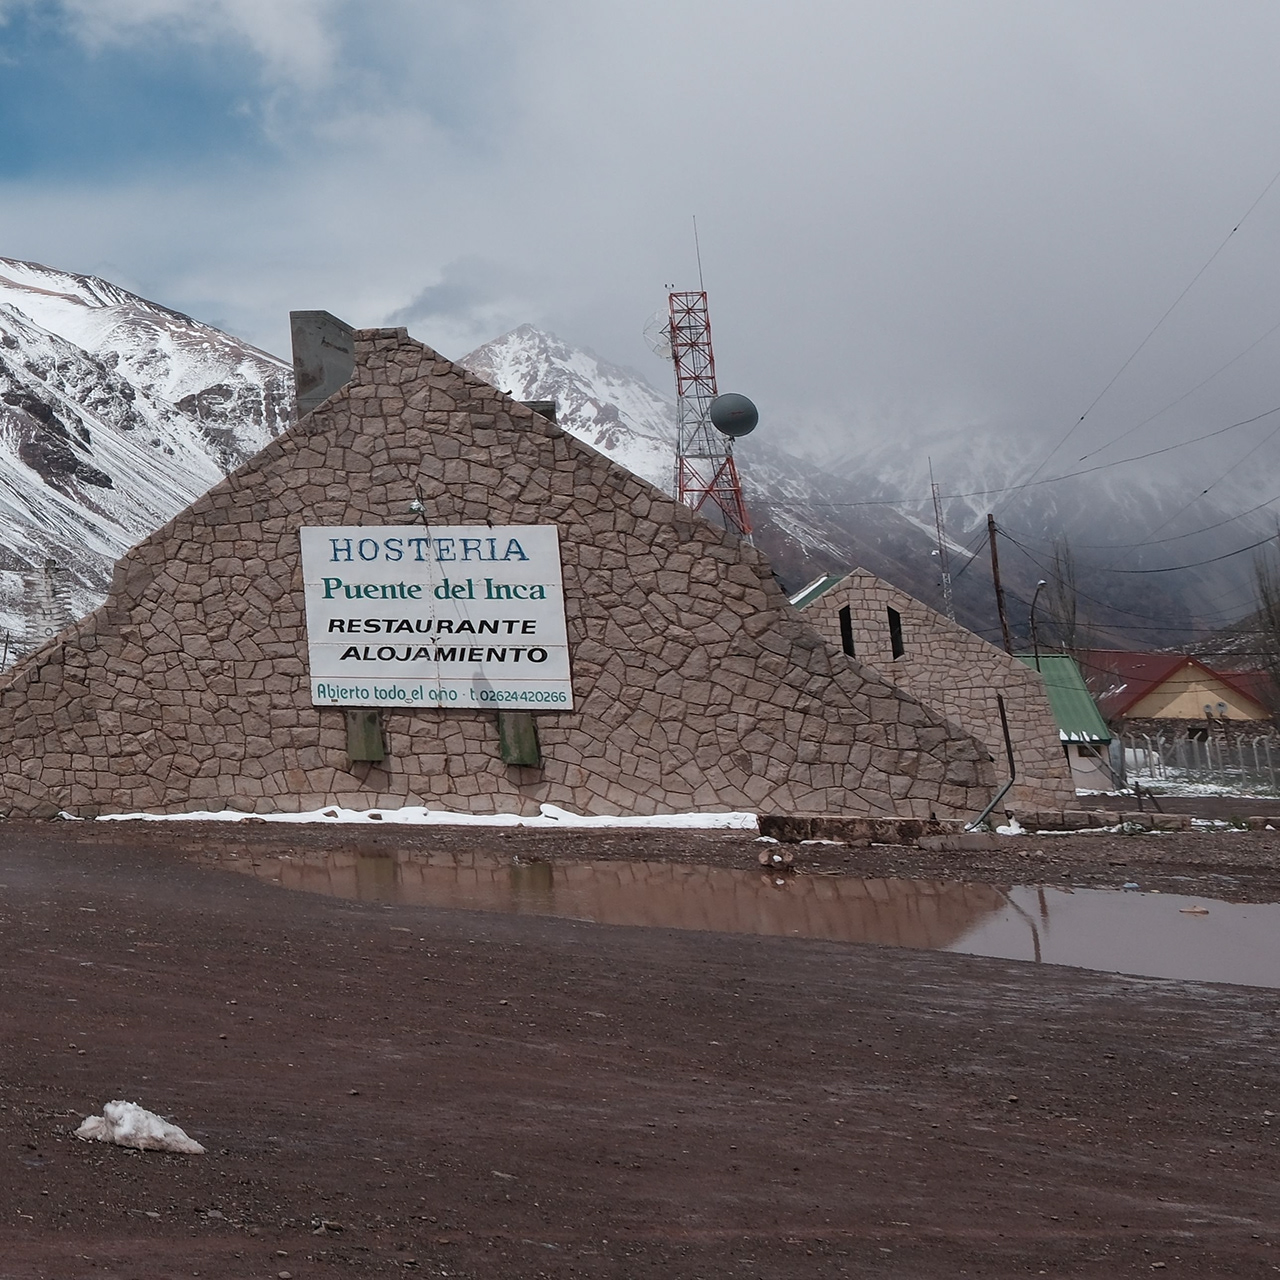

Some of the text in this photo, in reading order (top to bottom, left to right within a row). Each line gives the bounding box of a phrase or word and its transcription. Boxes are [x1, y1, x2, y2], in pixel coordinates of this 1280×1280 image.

[329, 537, 530, 562] HOSTERIA
[320, 577, 547, 600] Puente del Inca
[328, 618, 537, 635] RESTAURANTE
[339, 646, 548, 663] ALOJAMIENTO
[317, 683, 370, 699] Abierto
[374, 685, 407, 700] todo
[411, 685, 424, 700] el
[428, 687, 458, 701] año
